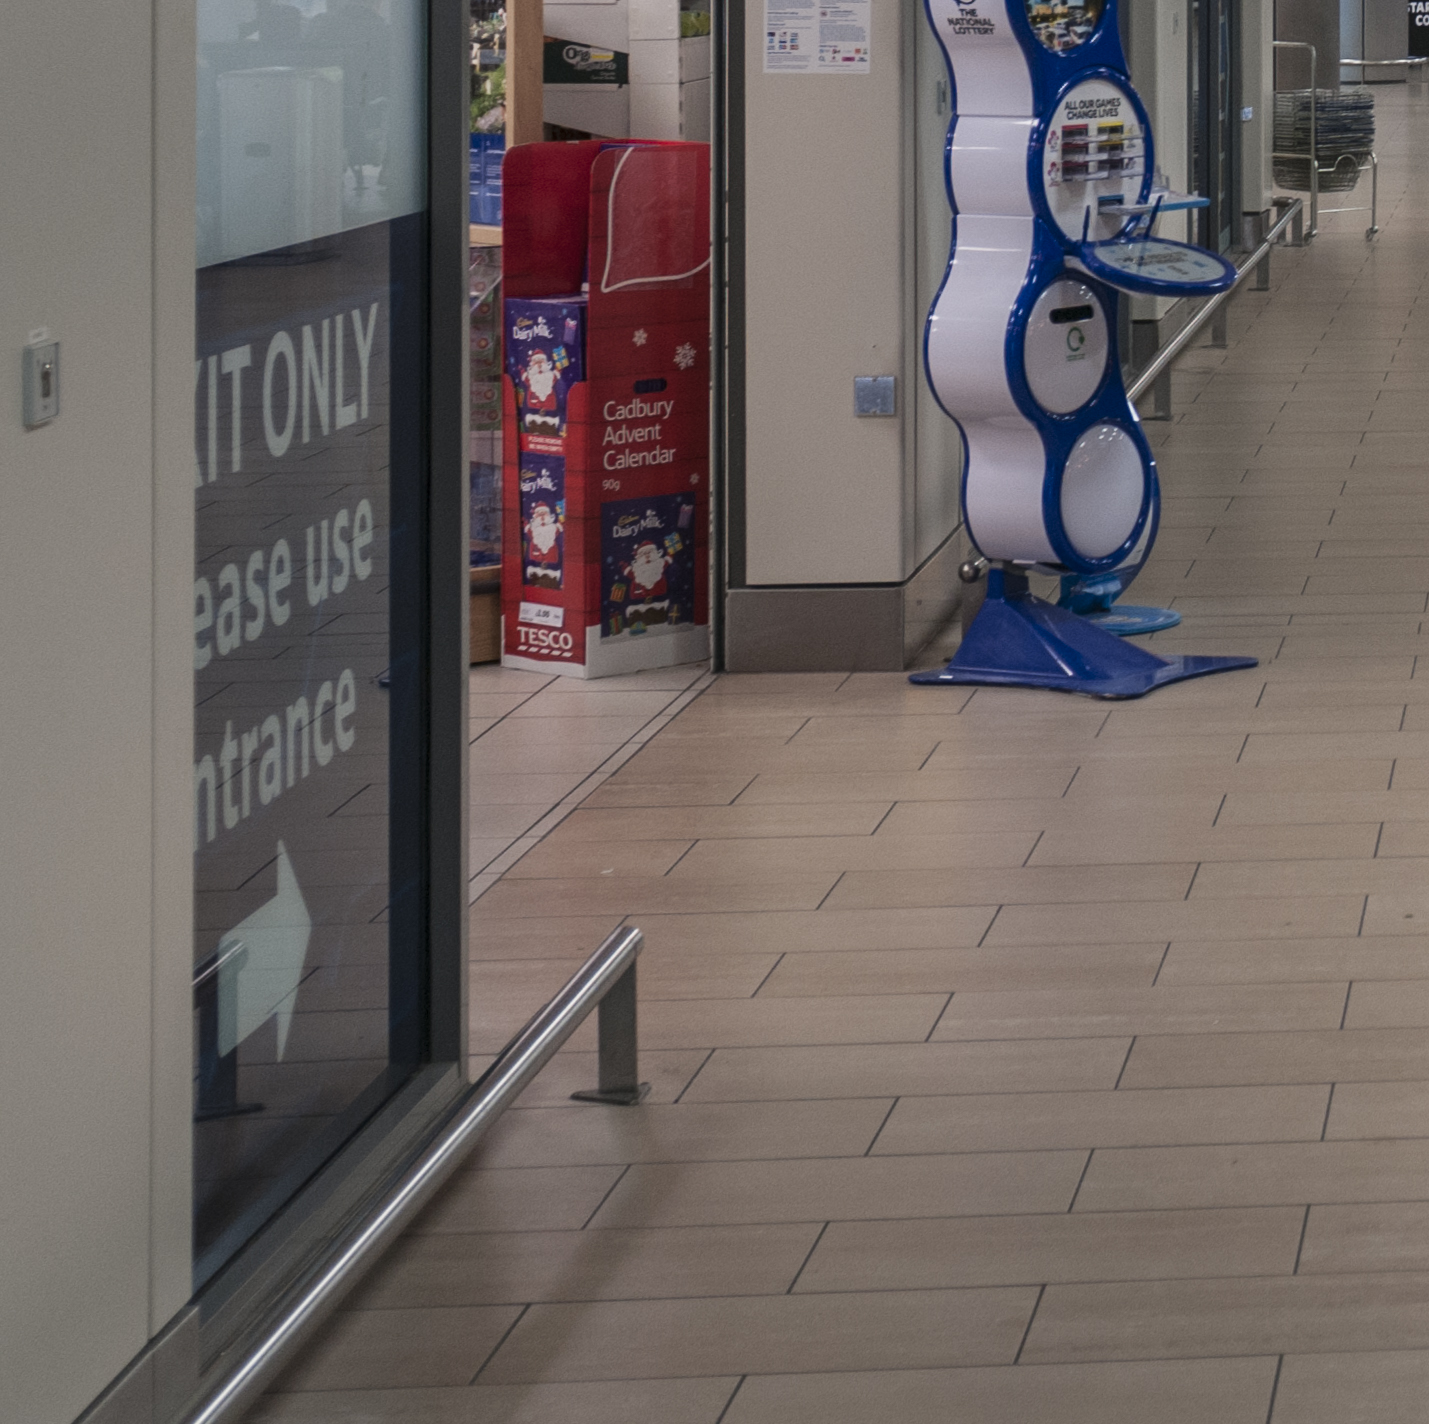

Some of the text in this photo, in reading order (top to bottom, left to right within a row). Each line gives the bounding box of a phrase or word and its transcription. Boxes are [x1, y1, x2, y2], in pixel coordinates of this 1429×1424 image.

[947, 17, 995, 27] NATIONAL
[958, 8, 978, 17] THE
[953, 26, 996, 36] LOTTERY
[1064, 97, 1121, 111] ALL OUR GAMES
[1066, 108, 1119, 121] CHANGE LIVES
[512, 324, 554, 341] Dairy Milk
[262, 302, 379, 458] ONLY
[602, 398, 674, 421] Cadbury
[602, 423, 662, 446] Advent
[603, 445, 676, 471] Calendar
[602, 478, 621, 492] 90g
[612, 517, 666, 539] Dairy Milk
[305, 498, 374, 608] use
[517, 626, 573, 650] TESCO
